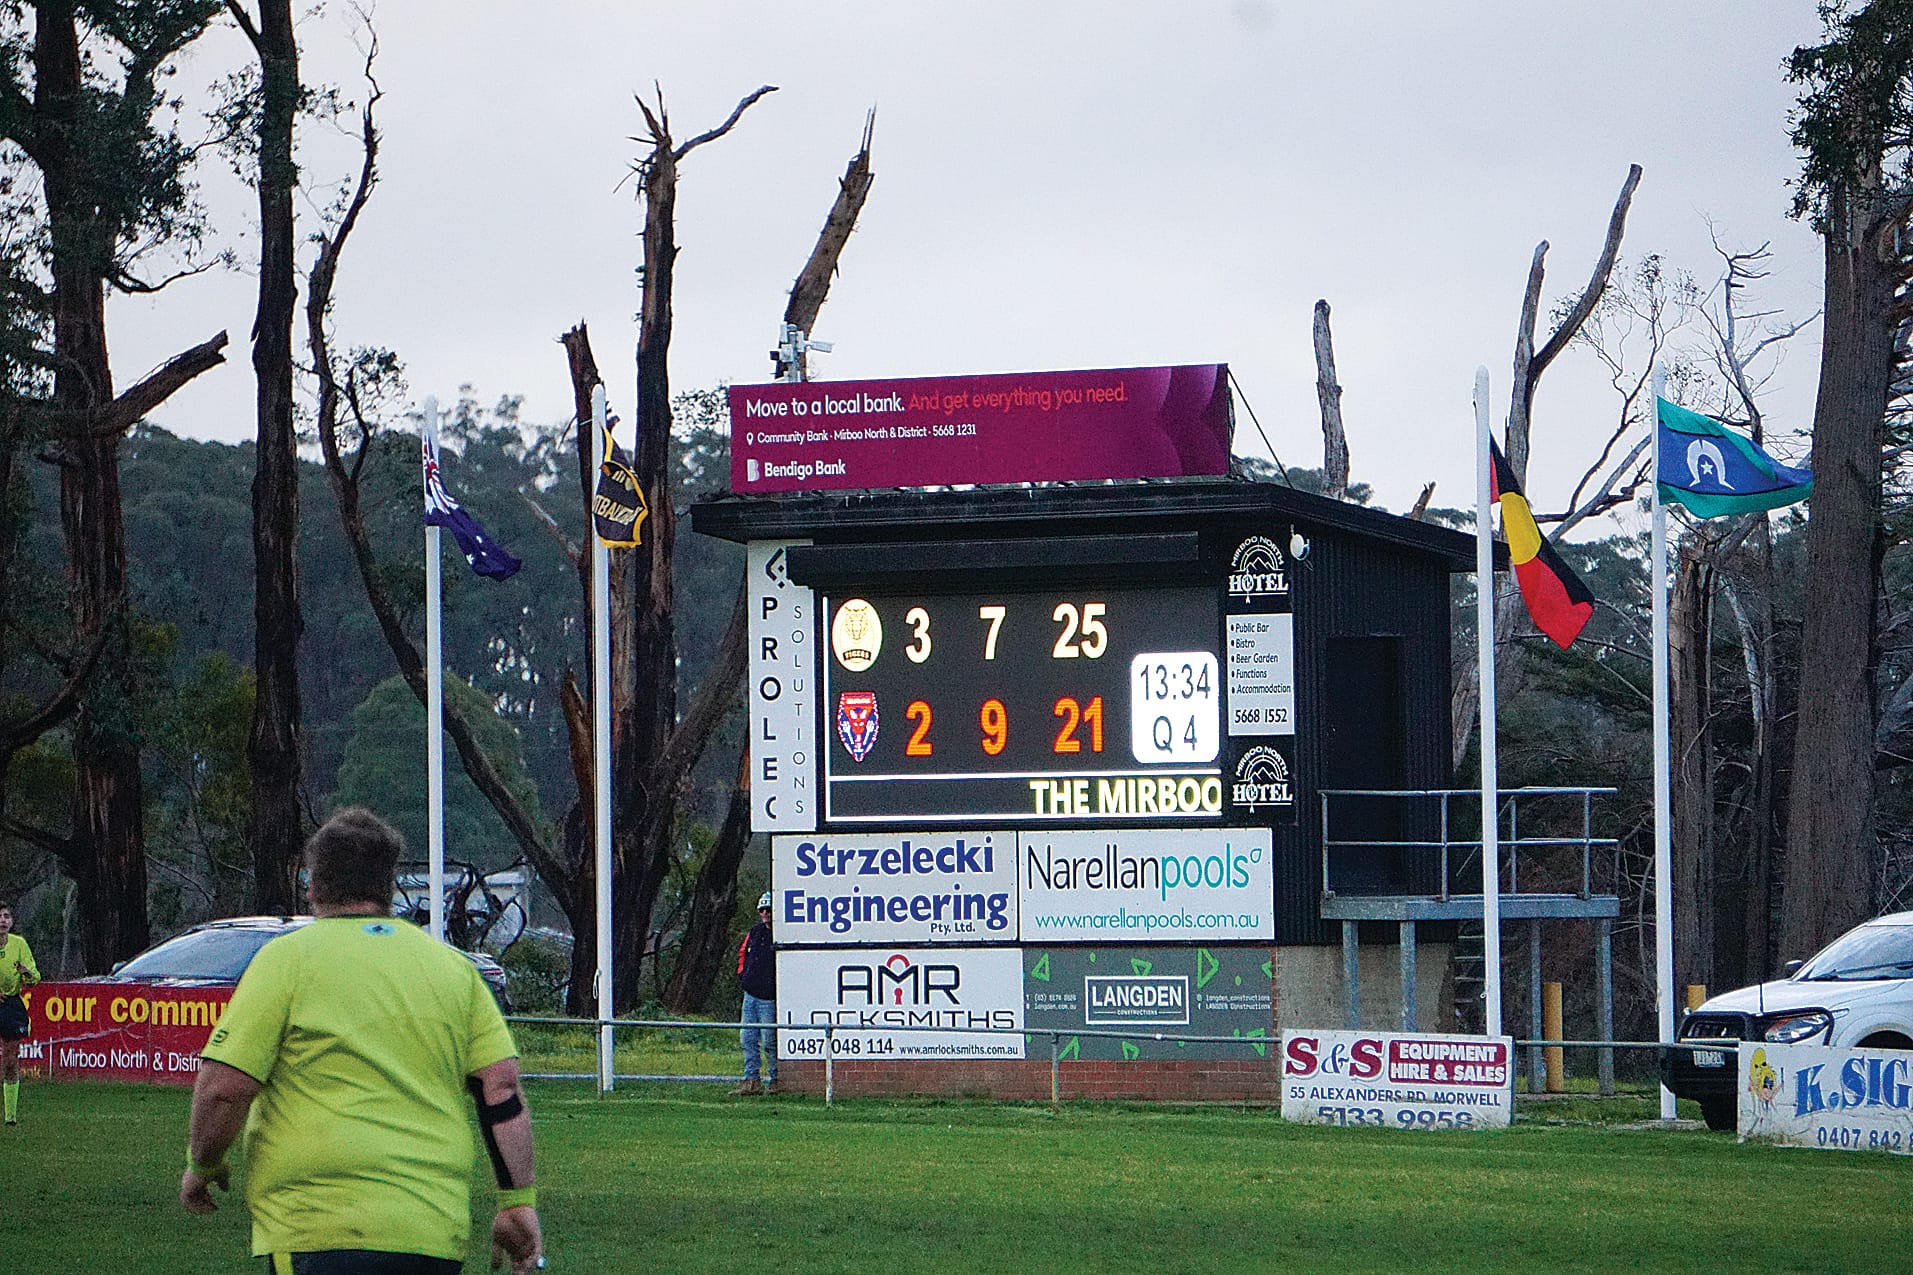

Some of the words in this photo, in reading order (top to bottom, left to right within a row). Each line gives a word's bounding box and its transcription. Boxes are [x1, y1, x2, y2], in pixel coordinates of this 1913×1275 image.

[746, 398, 788, 418] Move
[791, 398, 808, 416] to
[811, 401, 822, 416] a
[825, 393, 860, 415] local
[864, 391, 905, 414] bank.
[908, 389, 940, 411] And
[943, 390, 969, 416] get
[972, 386, 1051, 413] everything
[1055, 388, 1082, 410] you
[1086, 381, 1128, 403] need.
[757, 431, 805, 445] Community
[807, 428, 828, 442] Bank
[834, 429, 863, 441] Mirboo
[865, 427, 888, 440] North
[889, 427, 897, 438] &
[898, 425, 927, 438] District
[932, 425, 955, 437] 5668
[957, 423, 976, 436] 1231
[764, 461, 813, 481] Bendigo
[815, 458, 846, 476] Bank
[1231, 536, 1258, 567] MIRBOO
[1260, 536, 1285, 565] NORTH
[1228, 572, 1289, 592] HOTEL
[905, 606, 932, 664] 3
[979, 605, 1006, 660] 7
[1052, 602, 1108, 660] 25
[1235, 623, 1255, 633] Public
[1256, 623, 1269, 633] Bar
[1235, 638, 1255, 648] Bistro
[1236, 654, 1252, 664] Beer
[1253, 653, 1279, 664] Garden
[1140, 663, 1211, 700] 13:34
[1236, 669, 1267, 679] Functions
[1236, 683, 1291, 694] Accommodation
[760, 597, 781, 819] PROLEC
[791, 605, 805, 814] SOLUTIONS
[1235, 709, 1260, 724] 5668
[1264, 708, 1288, 723] 1552
[905, 699, 933, 756] 2
[980, 699, 1008, 756] 9
[1053, 695, 1103, 753] 21
[1153, 715, 1173, 754] Q
[1183, 714, 1198, 751] 4
[1235, 746, 1263, 777] MIRBOO
[1264, 746, 1289, 776] NORTH
[1029, 779, 1089, 815] THE
[1098, 777, 1222, 814] MIRBOO
[1232, 783, 1293, 802] HOTEL
[796, 836, 994, 876] Strzelecki
[1027, 842, 1250, 902] Narellanpools
[784, 883, 1009, 934] Engineering
[1035, 907, 1259, 933] www.narellanpools.com.au
[930, 923, 951, 936] Pty.
[955, 922, 976, 933] Ltd.
[837, 964, 960, 1005] AMR
[1092, 985, 1182, 1007] LANGDEN
[45, 995, 97, 1023] our
[788, 1038, 824, 1055] 0487
[831, 1038, 860, 1055] 048
[867, 1037, 894, 1054] 114
[899, 1043, 1018, 1056] www.amrlocksmiths.com.au
[1399, 1043, 1497, 1062] EQUIPMENT
[60, 1048, 107, 1069] Mirboo
[110, 1049, 149, 1069] North
[152, 1052, 164, 1072] &
[1390, 1064, 1430, 1080] HIRE
[1434, 1066, 1448, 1080] &
[1454, 1065, 1505, 1083] SALES
[1290, 1086, 1305, 1099] 55
[1309, 1087, 1402, 1102] ALEXANDERS
[1433, 1091, 1501, 1106] MORWELL
[1795, 1056, 1913, 1117] K.SIG
[1318, 1106, 1385, 1127] 5133
[1818, 1126, 1861, 1149] 0407
[1869, 1129, 1902, 1151] 842
